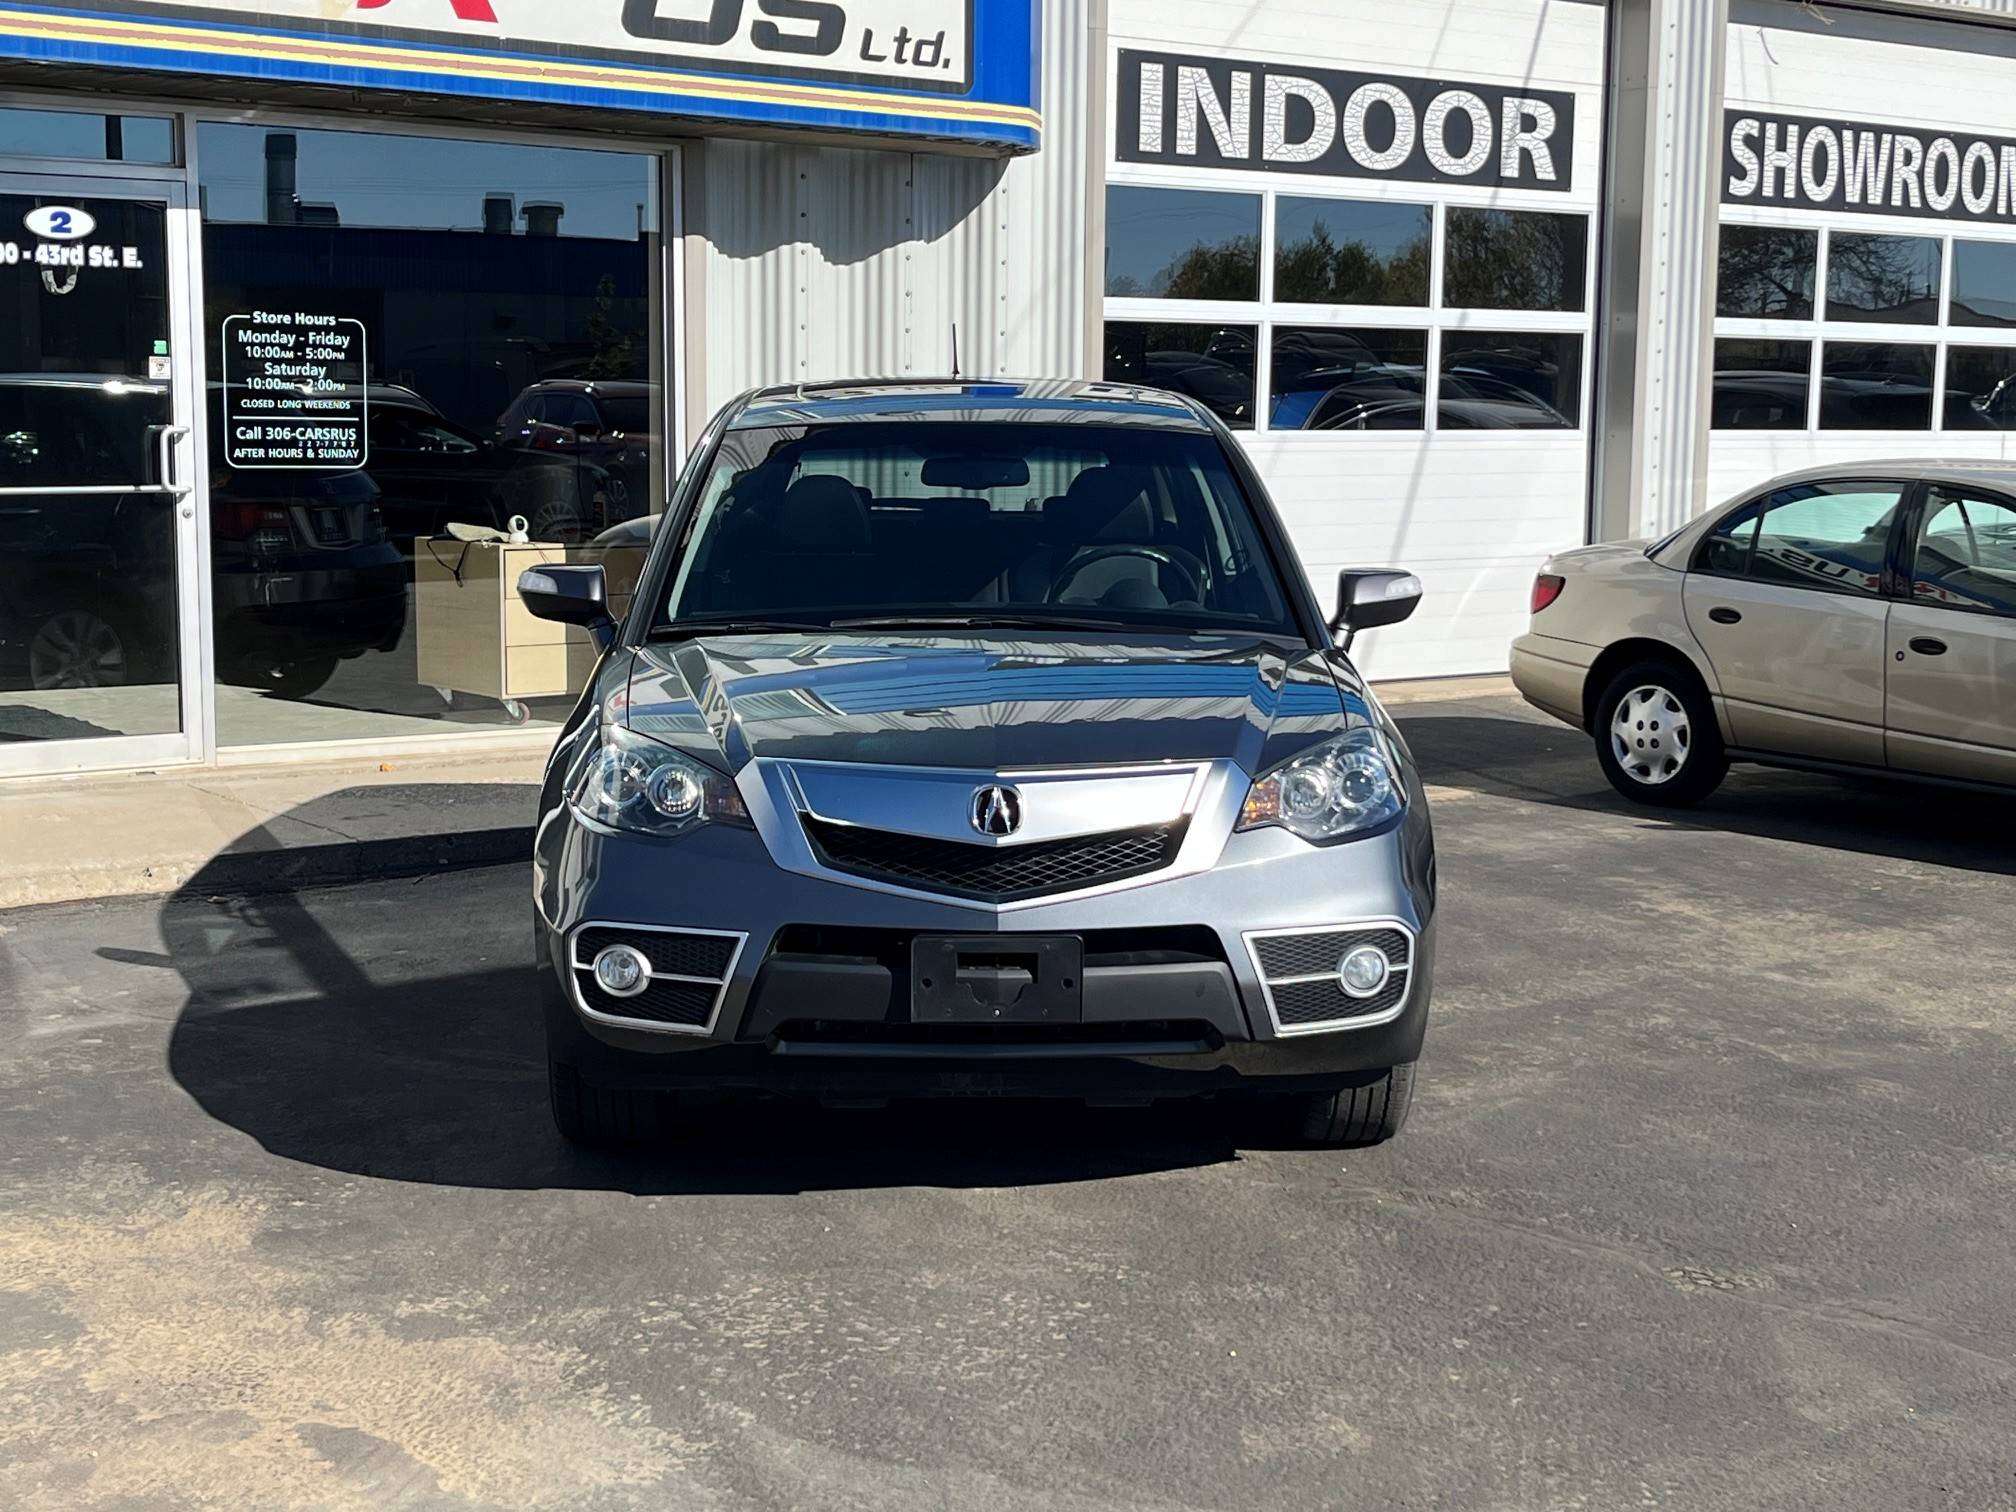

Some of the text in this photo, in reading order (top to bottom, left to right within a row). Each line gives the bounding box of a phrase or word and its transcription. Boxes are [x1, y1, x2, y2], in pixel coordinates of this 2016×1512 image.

[860, 26, 951, 69] Ltd.
[1137, 60, 1558, 182] INDOOR
[49, 211, 72, 233] 2
[35, 243, 84, 265] 43rd
[88, 246, 118, 267] St.
[122, 247, 143, 268] E.
[253, 311, 336, 325] Store Hours
[238, 330, 296, 347] Monday
[308, 332, 350, 348] Friday
[264, 362, 327, 379] Saturday
[241, 399, 351, 410] CLOSED LONG WEEKENDS
[236, 427, 357, 441] Call 306-CARSRUS
[233, 448, 359, 459] AFTER HOURS & SUNDAY
